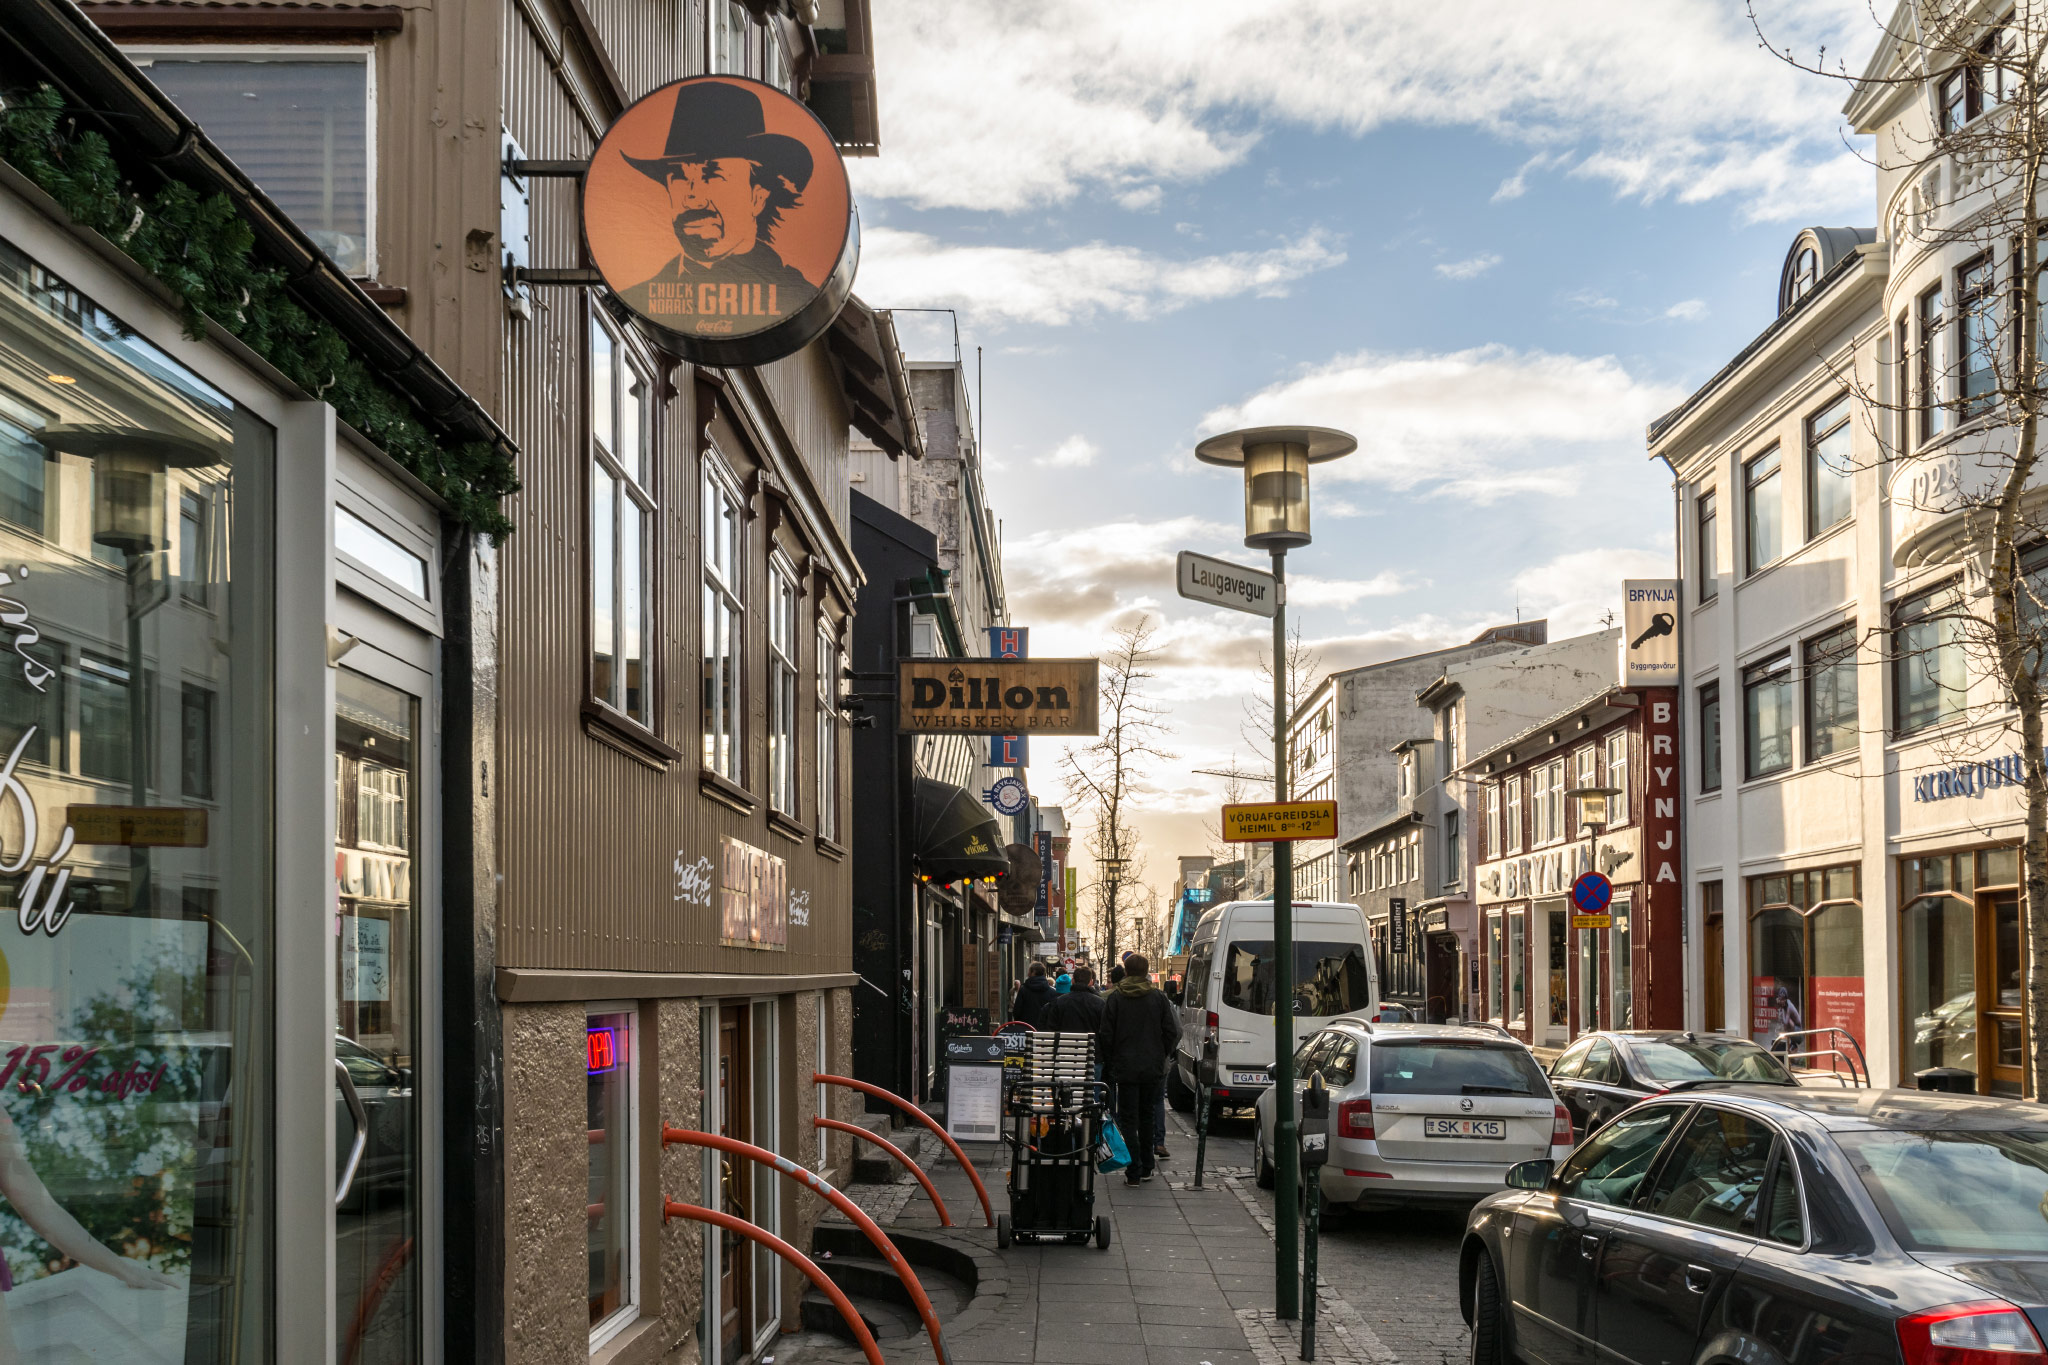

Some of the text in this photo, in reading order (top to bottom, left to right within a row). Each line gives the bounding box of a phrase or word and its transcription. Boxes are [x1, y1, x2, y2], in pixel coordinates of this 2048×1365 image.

[648, 282, 693, 298] CHUCK
[648, 299, 693, 315] NORRIS
[698, 283, 782, 316] GRILL
[1912, 458, 1960, 510] 1928
[1191, 562, 1266, 602] Laugavegur
[1629, 589, 1675, 601] BRYNJA
[1630, 662, 1676, 670] Byggingavörur
[911, 677, 1071, 710] Dillon
[912, 715, 1072, 728] WHISKEY BAR
[1652, 702, 1677, 883] BRYNJA
[1229, 809, 1330, 823] VÖRUAFGREIÐSLA
[1239, 823, 1277, 833] HEIMIL
[1506, 843, 1592, 898] BRYNJA
[948, 1043, 973, 1054] Carlsberg
[1437, 1121, 1498, 1134] SK K15
